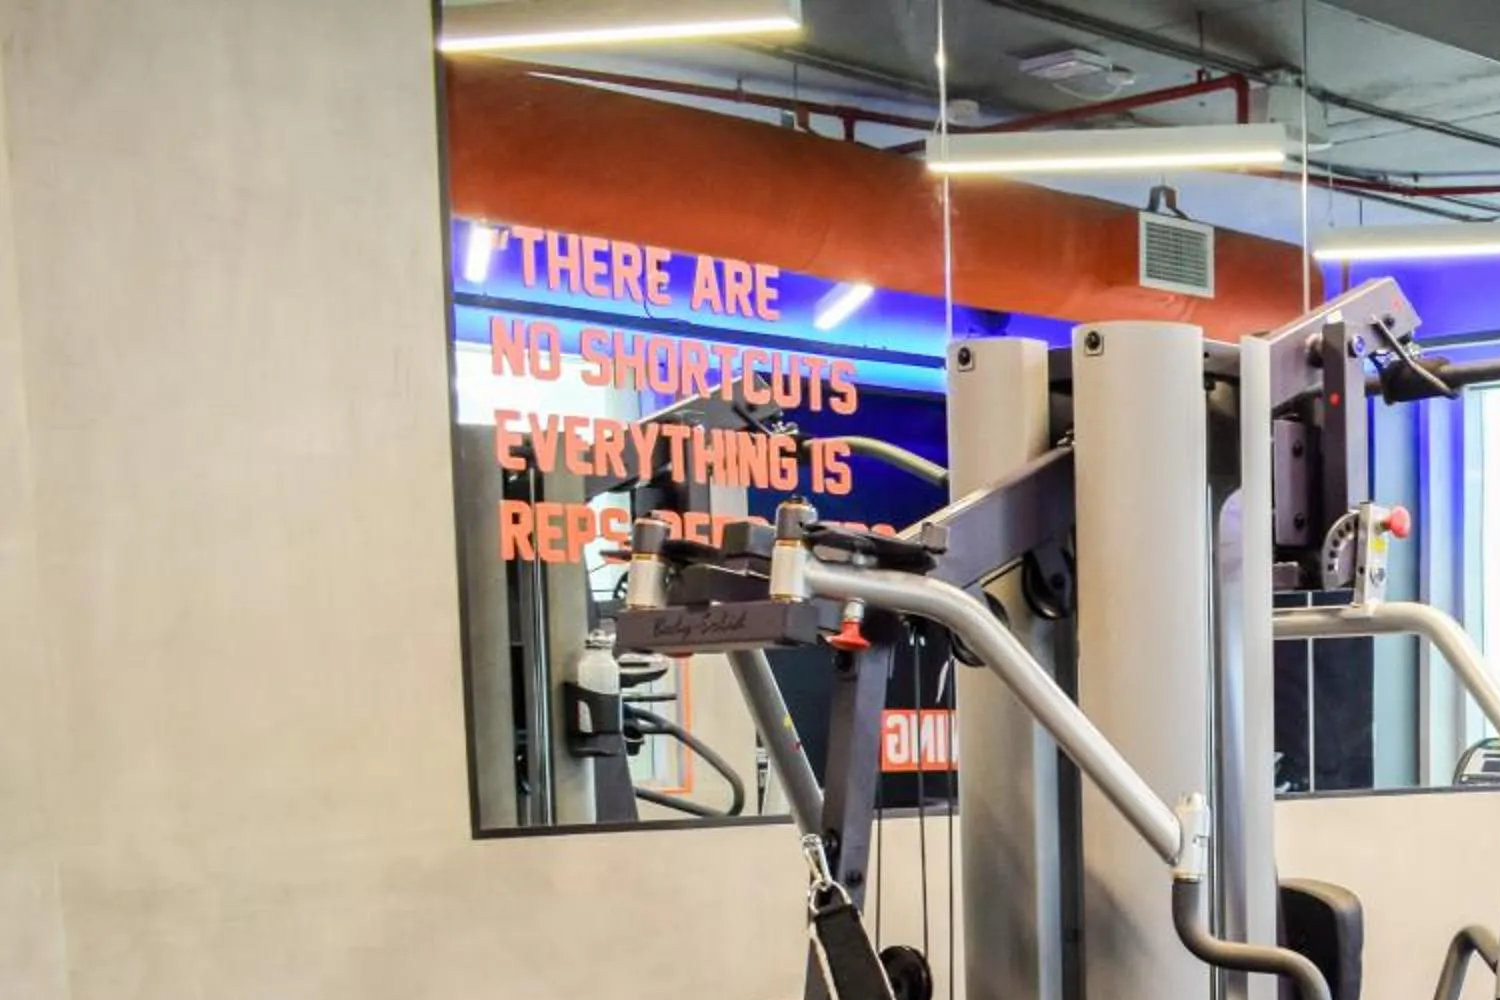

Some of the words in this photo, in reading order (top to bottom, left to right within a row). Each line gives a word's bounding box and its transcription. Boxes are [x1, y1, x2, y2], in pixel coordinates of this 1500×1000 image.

[690, 254, 782, 322] ARE
[490, 316, 562, 382] NO
[579, 328, 860, 416] SHORTCUTS
[493, 408, 800, 493] EVERYTHING
[810, 437, 854, 496] IS
[499, 500, 633, 564] REPS
